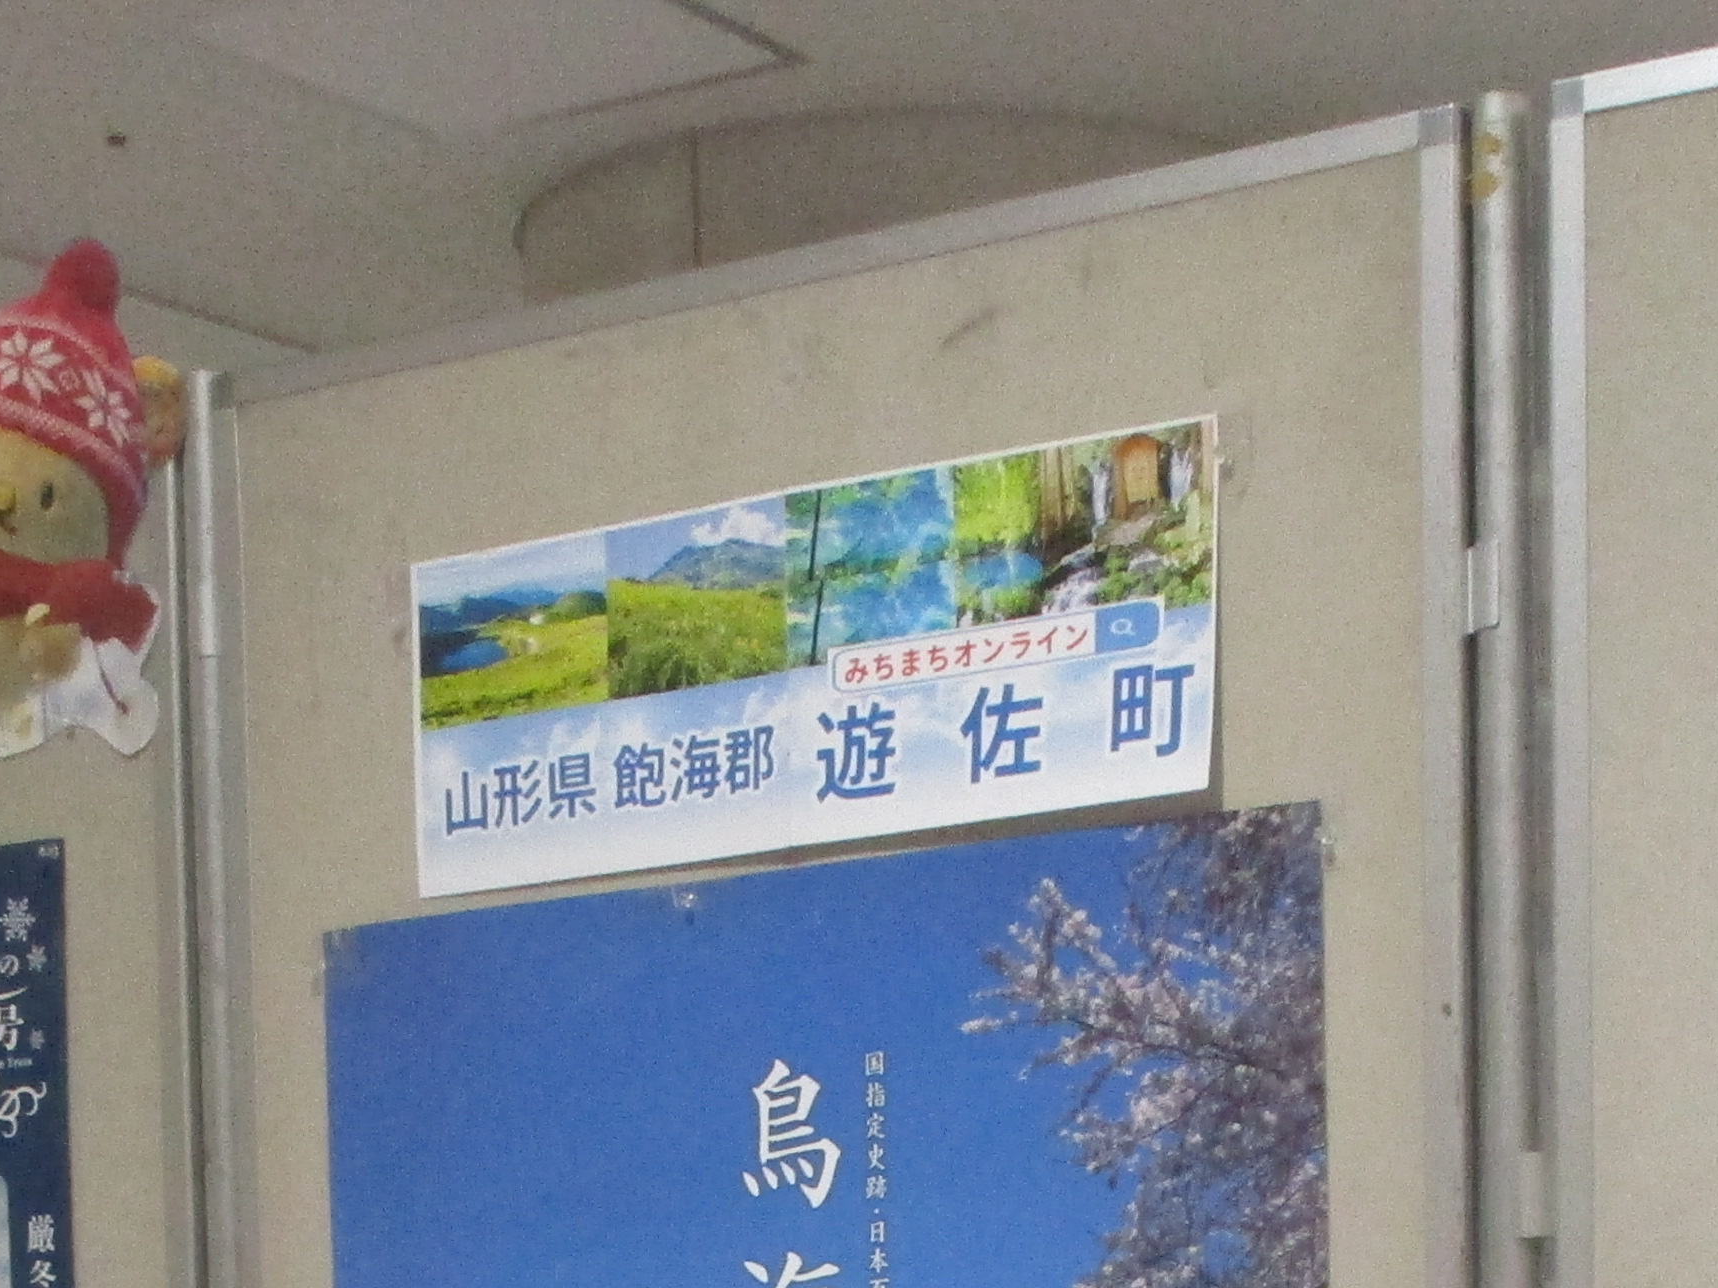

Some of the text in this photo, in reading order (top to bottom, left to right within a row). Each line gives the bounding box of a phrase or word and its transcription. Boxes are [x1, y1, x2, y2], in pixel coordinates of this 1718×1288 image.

[845, 613, 1090, 688] みちまちオンライン
[444, 661, 1195, 838] 山形県 飽海郡 遊佐町
